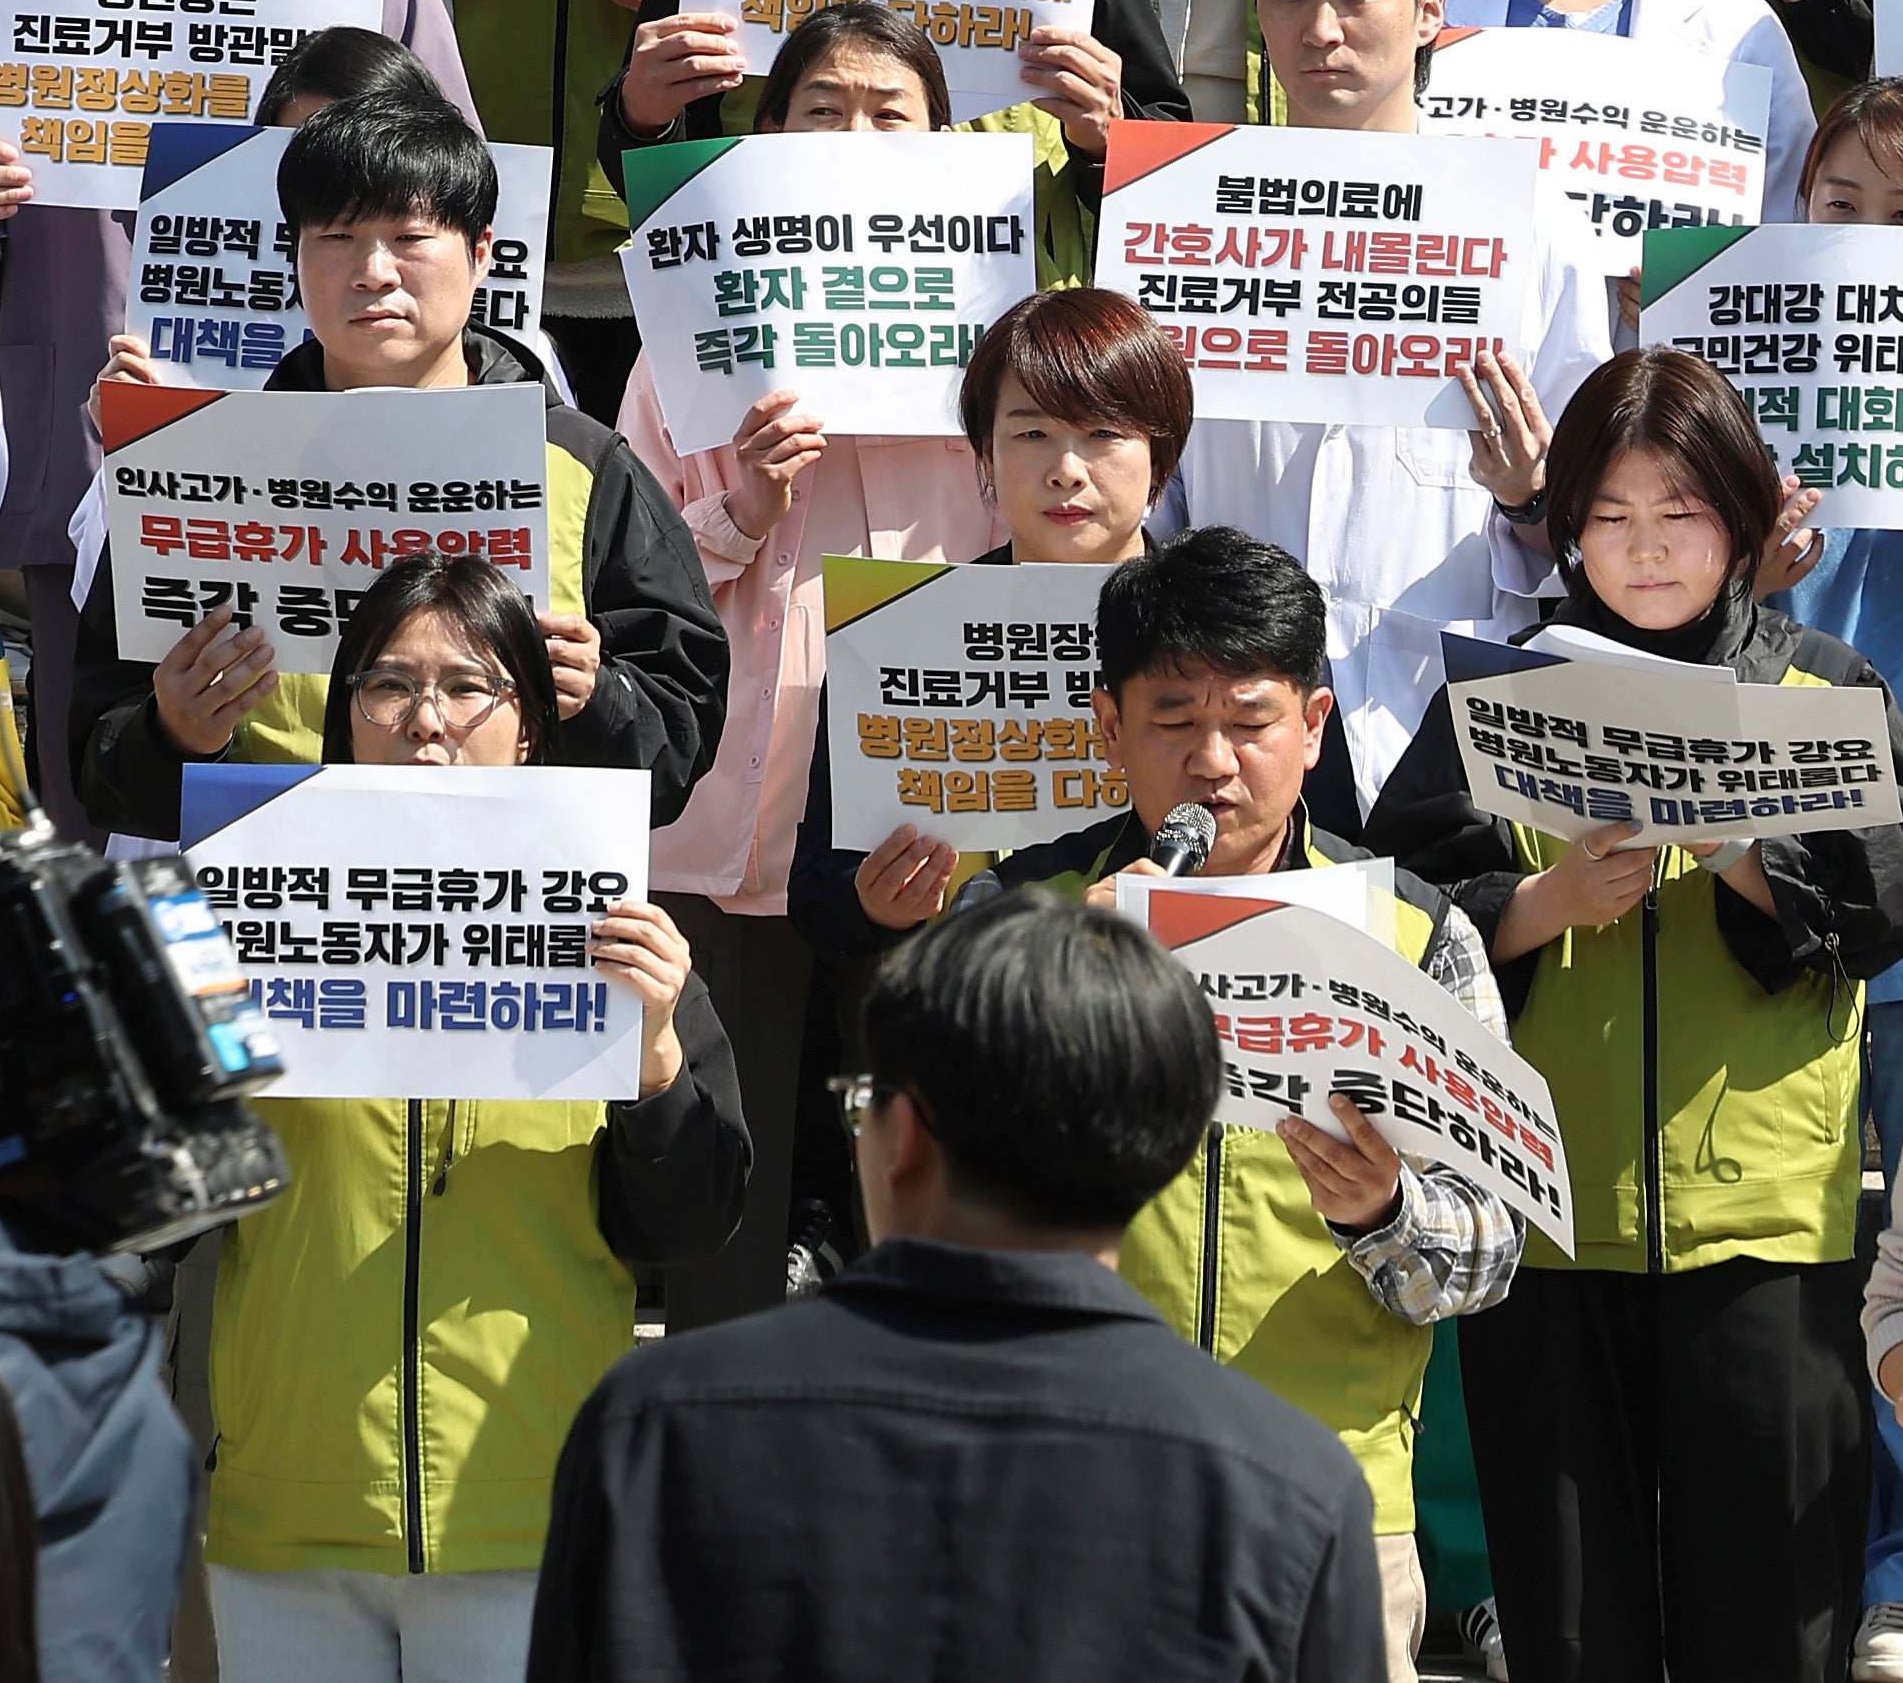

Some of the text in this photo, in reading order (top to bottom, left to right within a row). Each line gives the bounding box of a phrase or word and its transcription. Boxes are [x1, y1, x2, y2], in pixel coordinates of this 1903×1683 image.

[1215, 175, 1423, 222] 불법의료에
[646, 213, 1026, 270] 환자 생명이 우선이다
[1123, 221, 1508, 279] 간호사가 내몰린다
[713, 265, 956, 319] 환자 곁으로
[1316, 281, 1481, 325] 전공의들
[1466, 697, 1876, 765] 일방적 무급휴가 강요
[1717, 763, 1883, 794] 위태롭다
[1650, 789, 1865, 826] 마련하라!
[346, 868, 528, 913] 무급휴가
[386, 980, 608, 1033] 마련하라!
